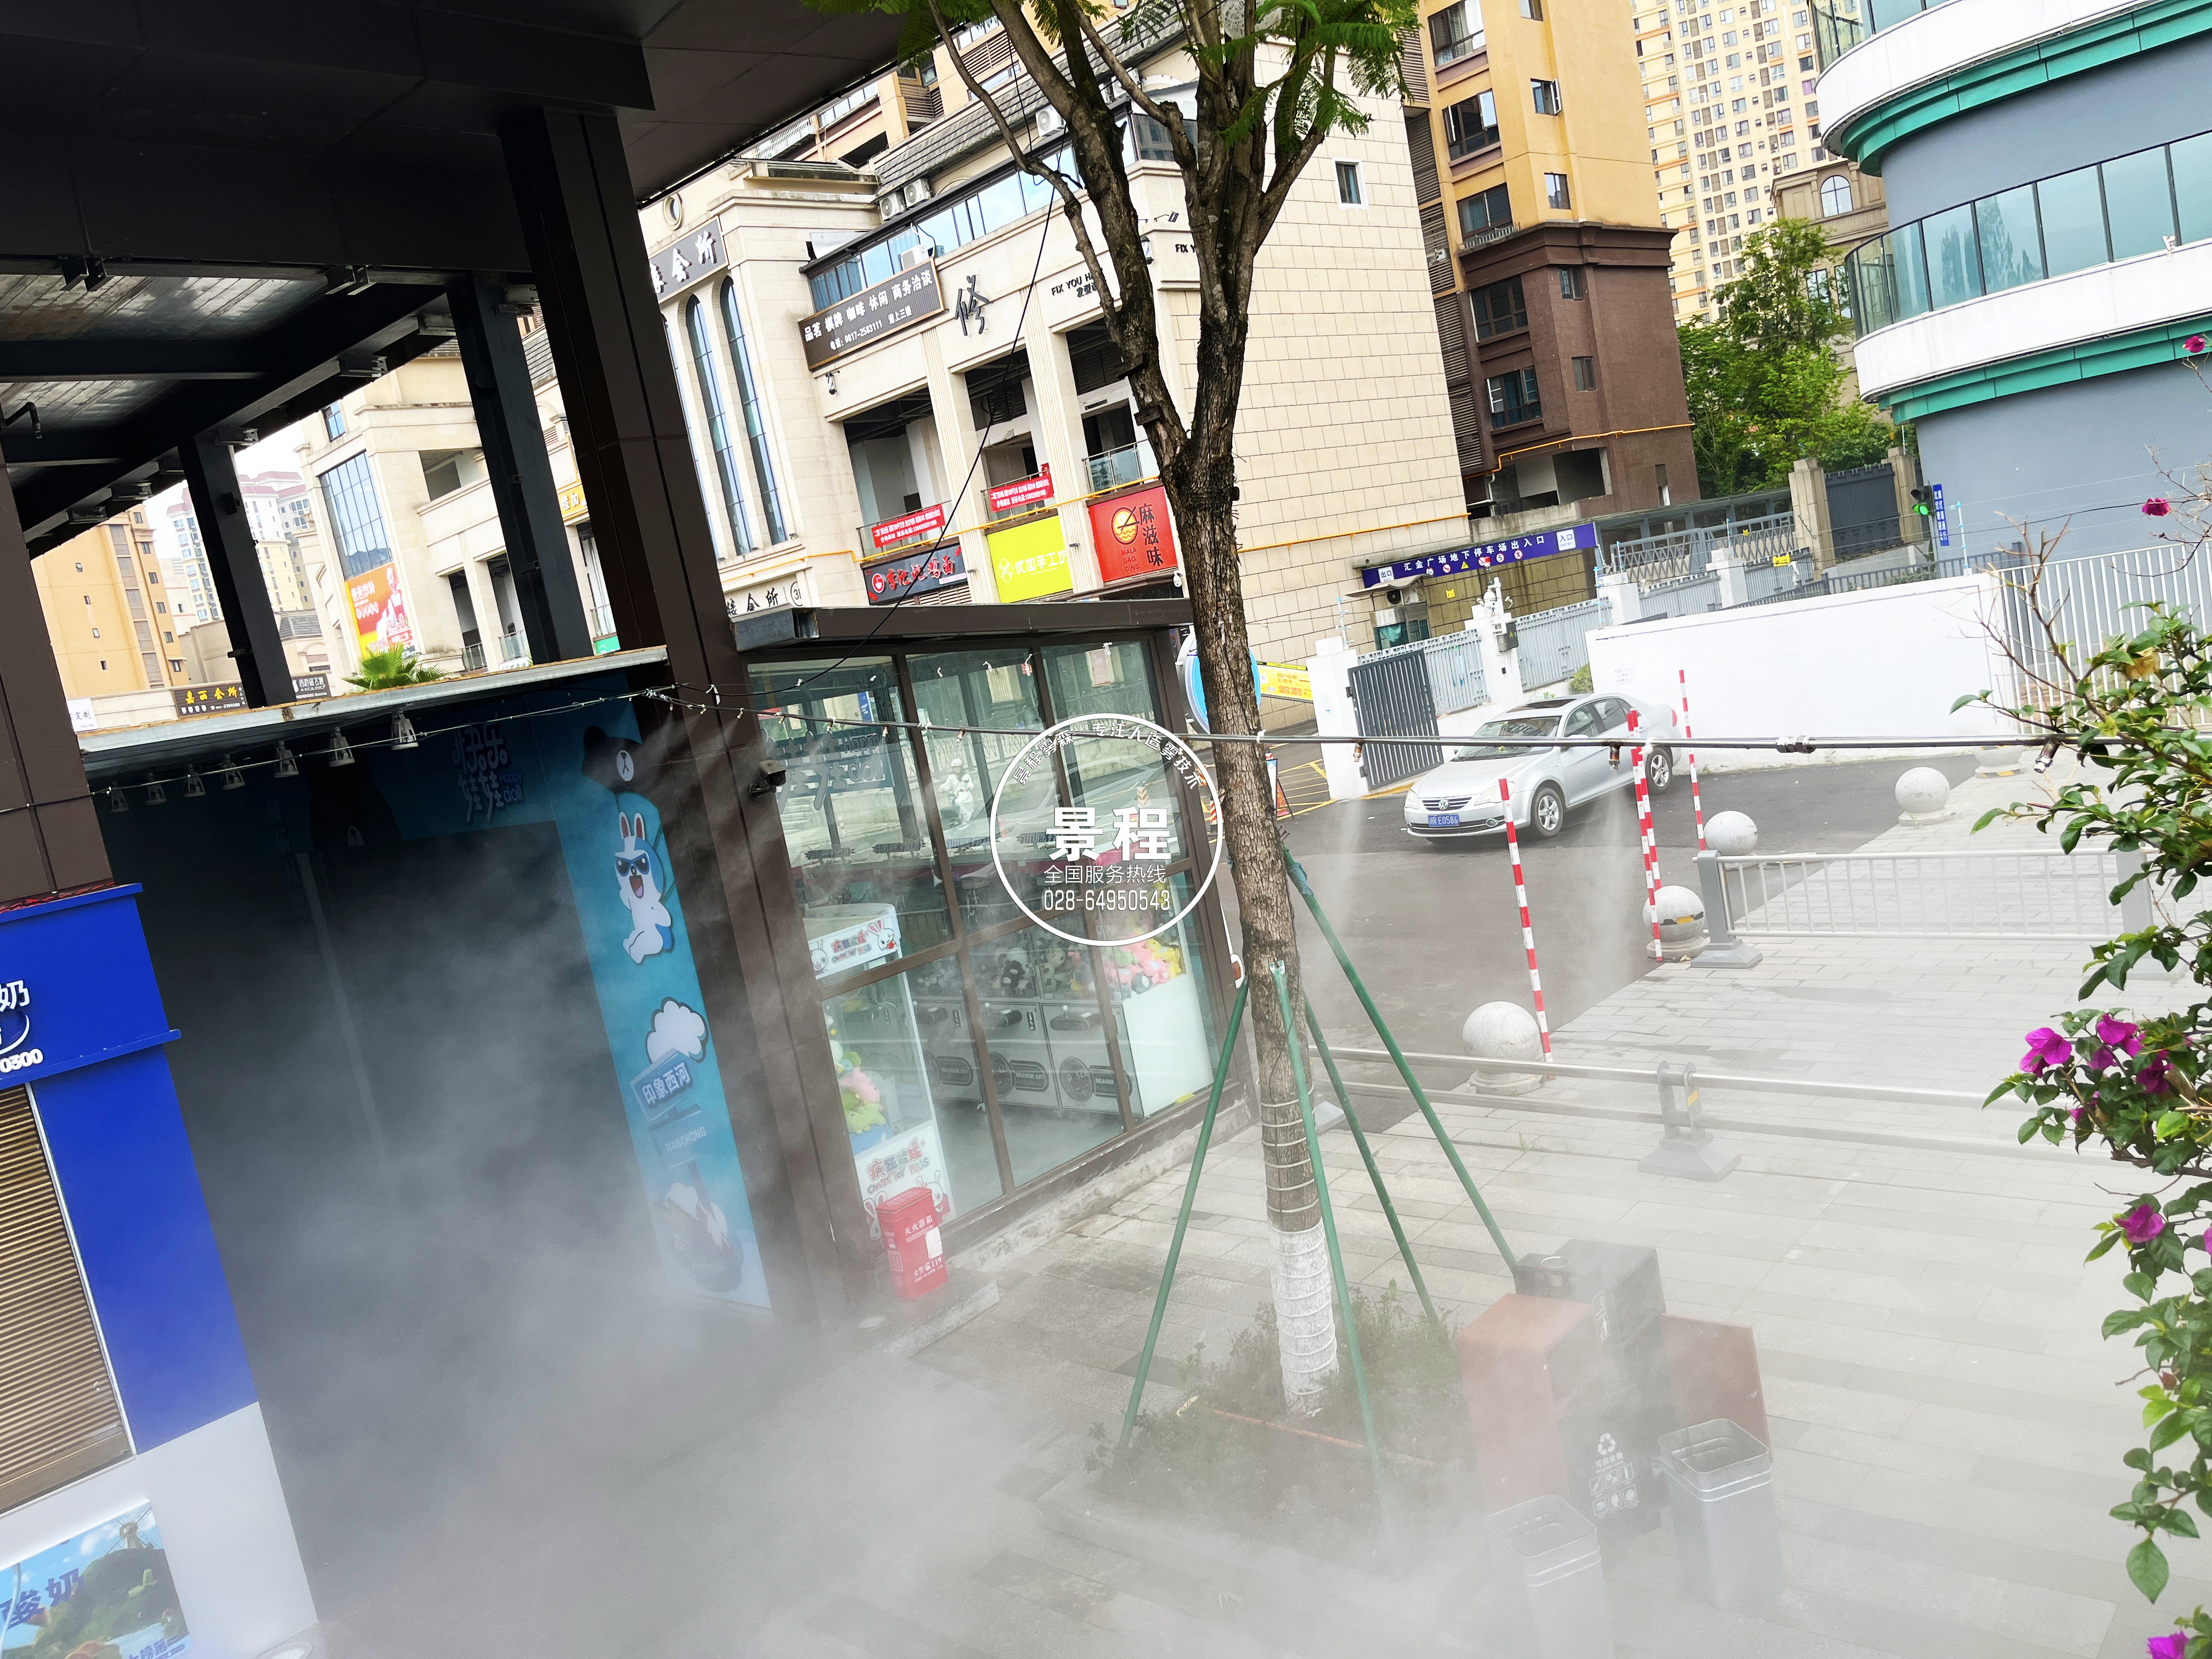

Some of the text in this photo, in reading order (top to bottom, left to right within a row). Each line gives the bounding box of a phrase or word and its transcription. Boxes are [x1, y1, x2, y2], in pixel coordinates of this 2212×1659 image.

[1175, 244, 1188, 253] FIX
[1051, 284, 1064, 296] FIX
[1065, 276, 1082, 289] YOU
[804, 269, 932, 342] 品茗 棋牌 咖啡 休闲 商务洽谈
[1139, 503, 1163, 566] 麻滋味
[1404, 534, 1573, 571] 汇金广场地下停车场出入口 入口
[499, 772, 522, 786] Happy
[457, 770, 504, 823] 娃娃
[504, 784, 523, 803] doll
[642, 1062, 691, 1105] 印象西河
[664, 1126, 707, 1153] NANCHONG
[909, 1157, 929, 1175] PLUS
[905, 1215, 933, 1236] 灭火器箱
[932, 1256, 942, 1267] 119
